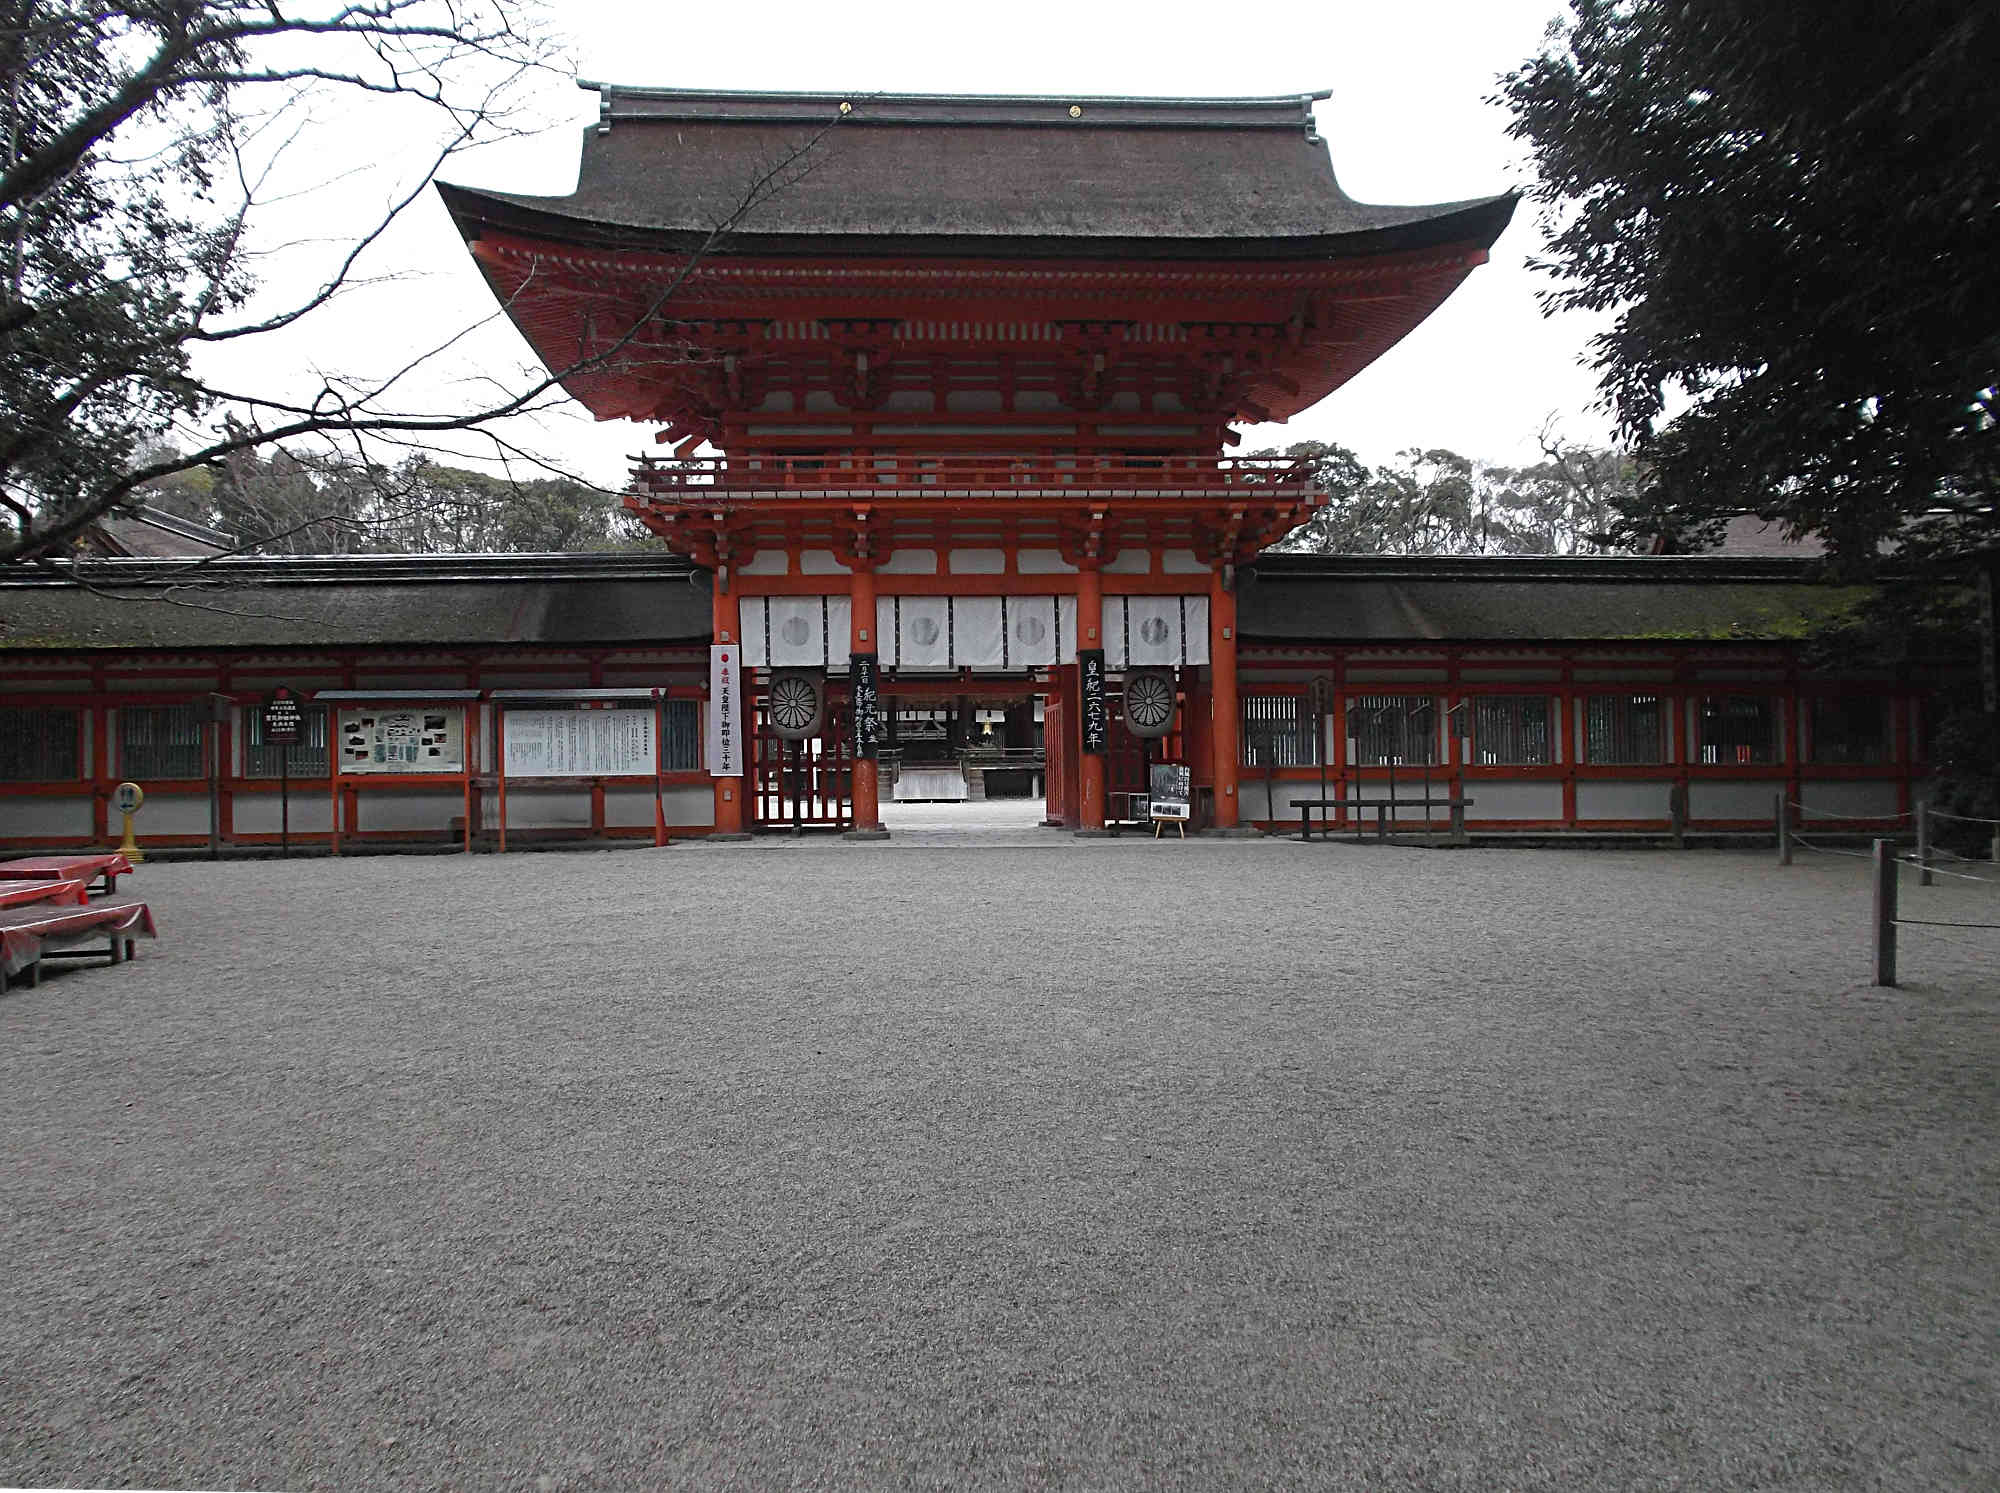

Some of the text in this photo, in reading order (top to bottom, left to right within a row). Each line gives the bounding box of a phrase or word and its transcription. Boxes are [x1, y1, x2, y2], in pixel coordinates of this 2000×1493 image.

[1086, 660, 1103, 749] 皇紀二六七九年
